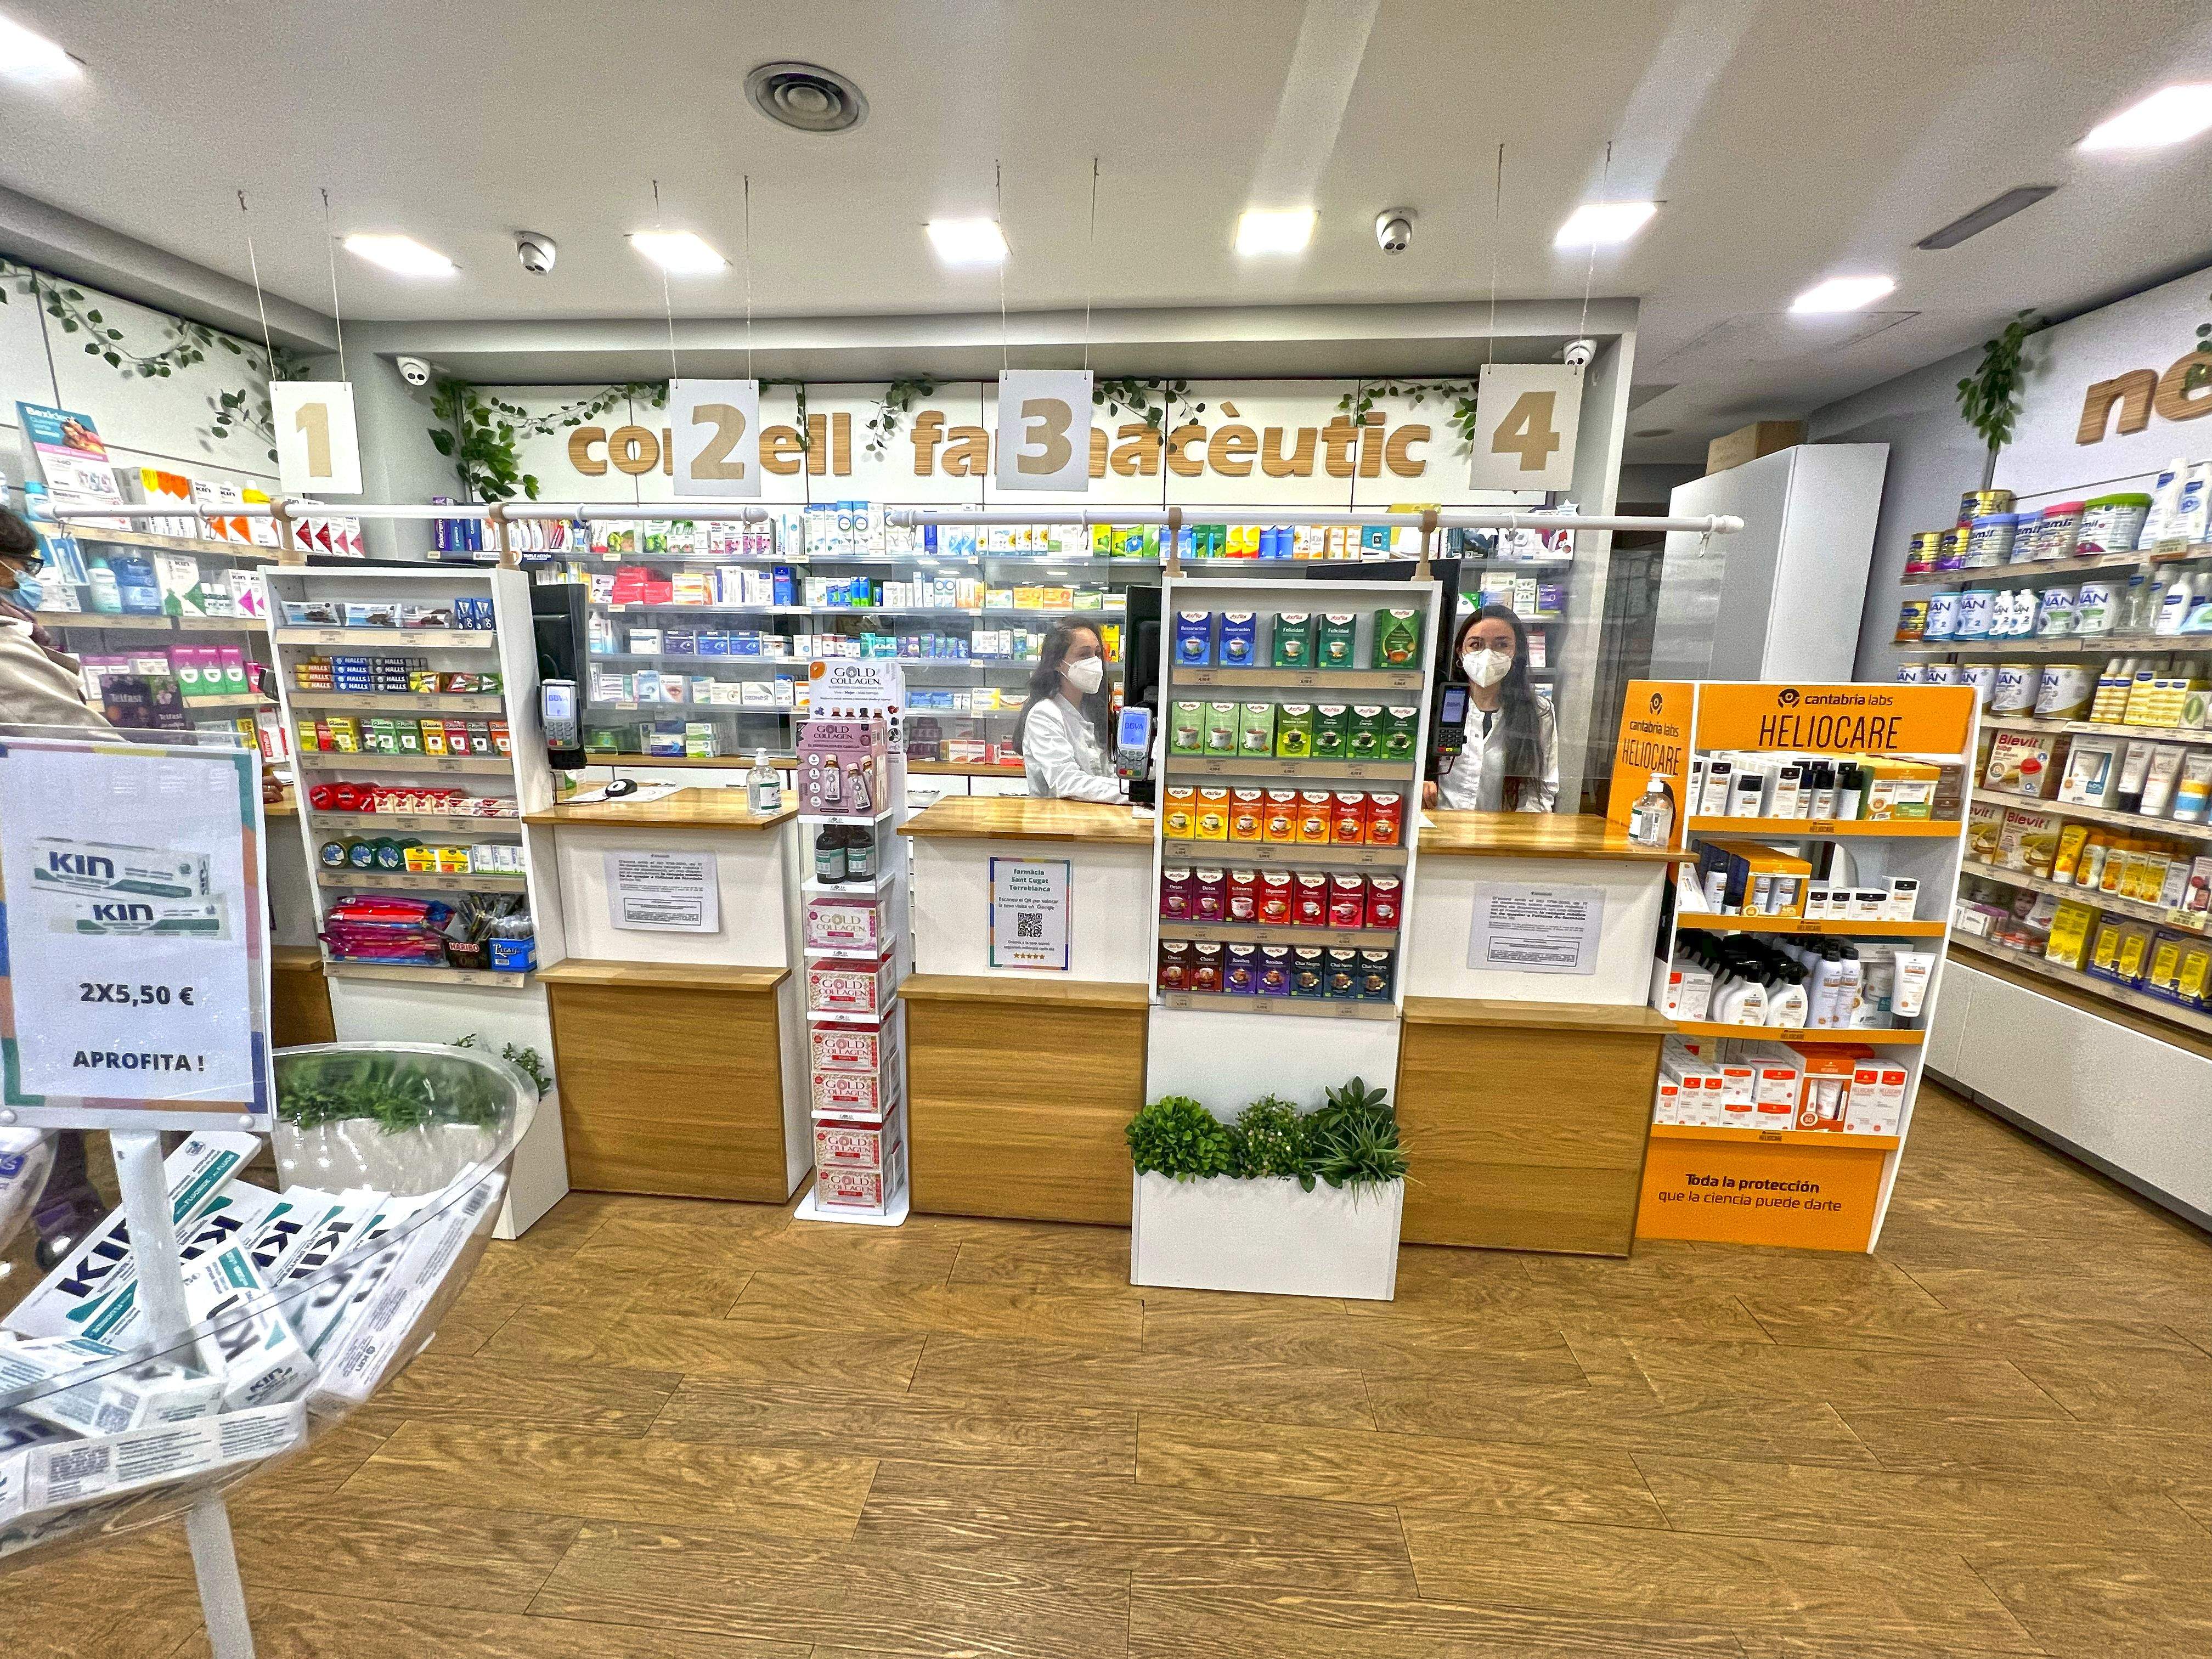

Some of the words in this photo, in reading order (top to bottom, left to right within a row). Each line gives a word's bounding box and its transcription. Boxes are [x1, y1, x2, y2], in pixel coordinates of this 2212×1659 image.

[1017, 399, 1073, 475] 3
[1492, 391, 1560, 471] 4
[295, 403, 332, 477] 1
[568, 412, 851, 477] coell
[911, 401, 1431, 478] faacèutic
[691, 404, 746, 480] 2
[1930, 602, 1951, 611] AN
[834, 666, 876, 678] GOLD
[1897, 673, 1917, 682] AN
[1926, 671, 1947, 682] AN
[110, 693, 143, 703] Telfast
[1805, 693, 1865, 706] cantabria
[1867, 693, 1893, 707] labs
[816, 725, 849, 734] GOLD
[1629, 719, 1663, 735] cantabria
[1663, 723, 1679, 738] labs
[1758, 715, 1903, 749] HELIOCARE
[263, 734, 272, 757] elmex
[1998, 734, 2039, 748] Blevit
[1622, 738, 1681, 776] HELIOCARE
[1970, 806, 1990, 817] evit
[2006, 812, 2045, 828] Blevit
[49, 850, 114, 879] KIN
[92, 903, 154, 922] KIN
[820, 913, 861, 925] GOLD
[449, 942, 480, 952] HARIBO
[822, 978, 863, 990] GOLD
[80, 982, 171, 1007] 2X5,50
[179, 986, 194, 1007] €
[825, 1038, 865, 1049] GOLD
[73, 1049, 192, 1072] APROFITA
[198, 1055, 204, 1072] !
[826, 1079, 865, 1090] GOLD
[828, 1136, 867, 1147] GOLD
[831, 1175, 869, 1186] GOLD
[1685, 1173, 1719, 1189] Toda
[1723, 1175, 1736, 1189] la
[1738, 1176, 1820, 1194] protección
[1658, 1191, 1685, 1206] que
[1688, 1190, 1700, 1203] la
[1703, 1190, 1752, 1206] ciencia
[1756, 1194, 1801, 1209] puede
[1804, 1197, 1842, 1212] darte
